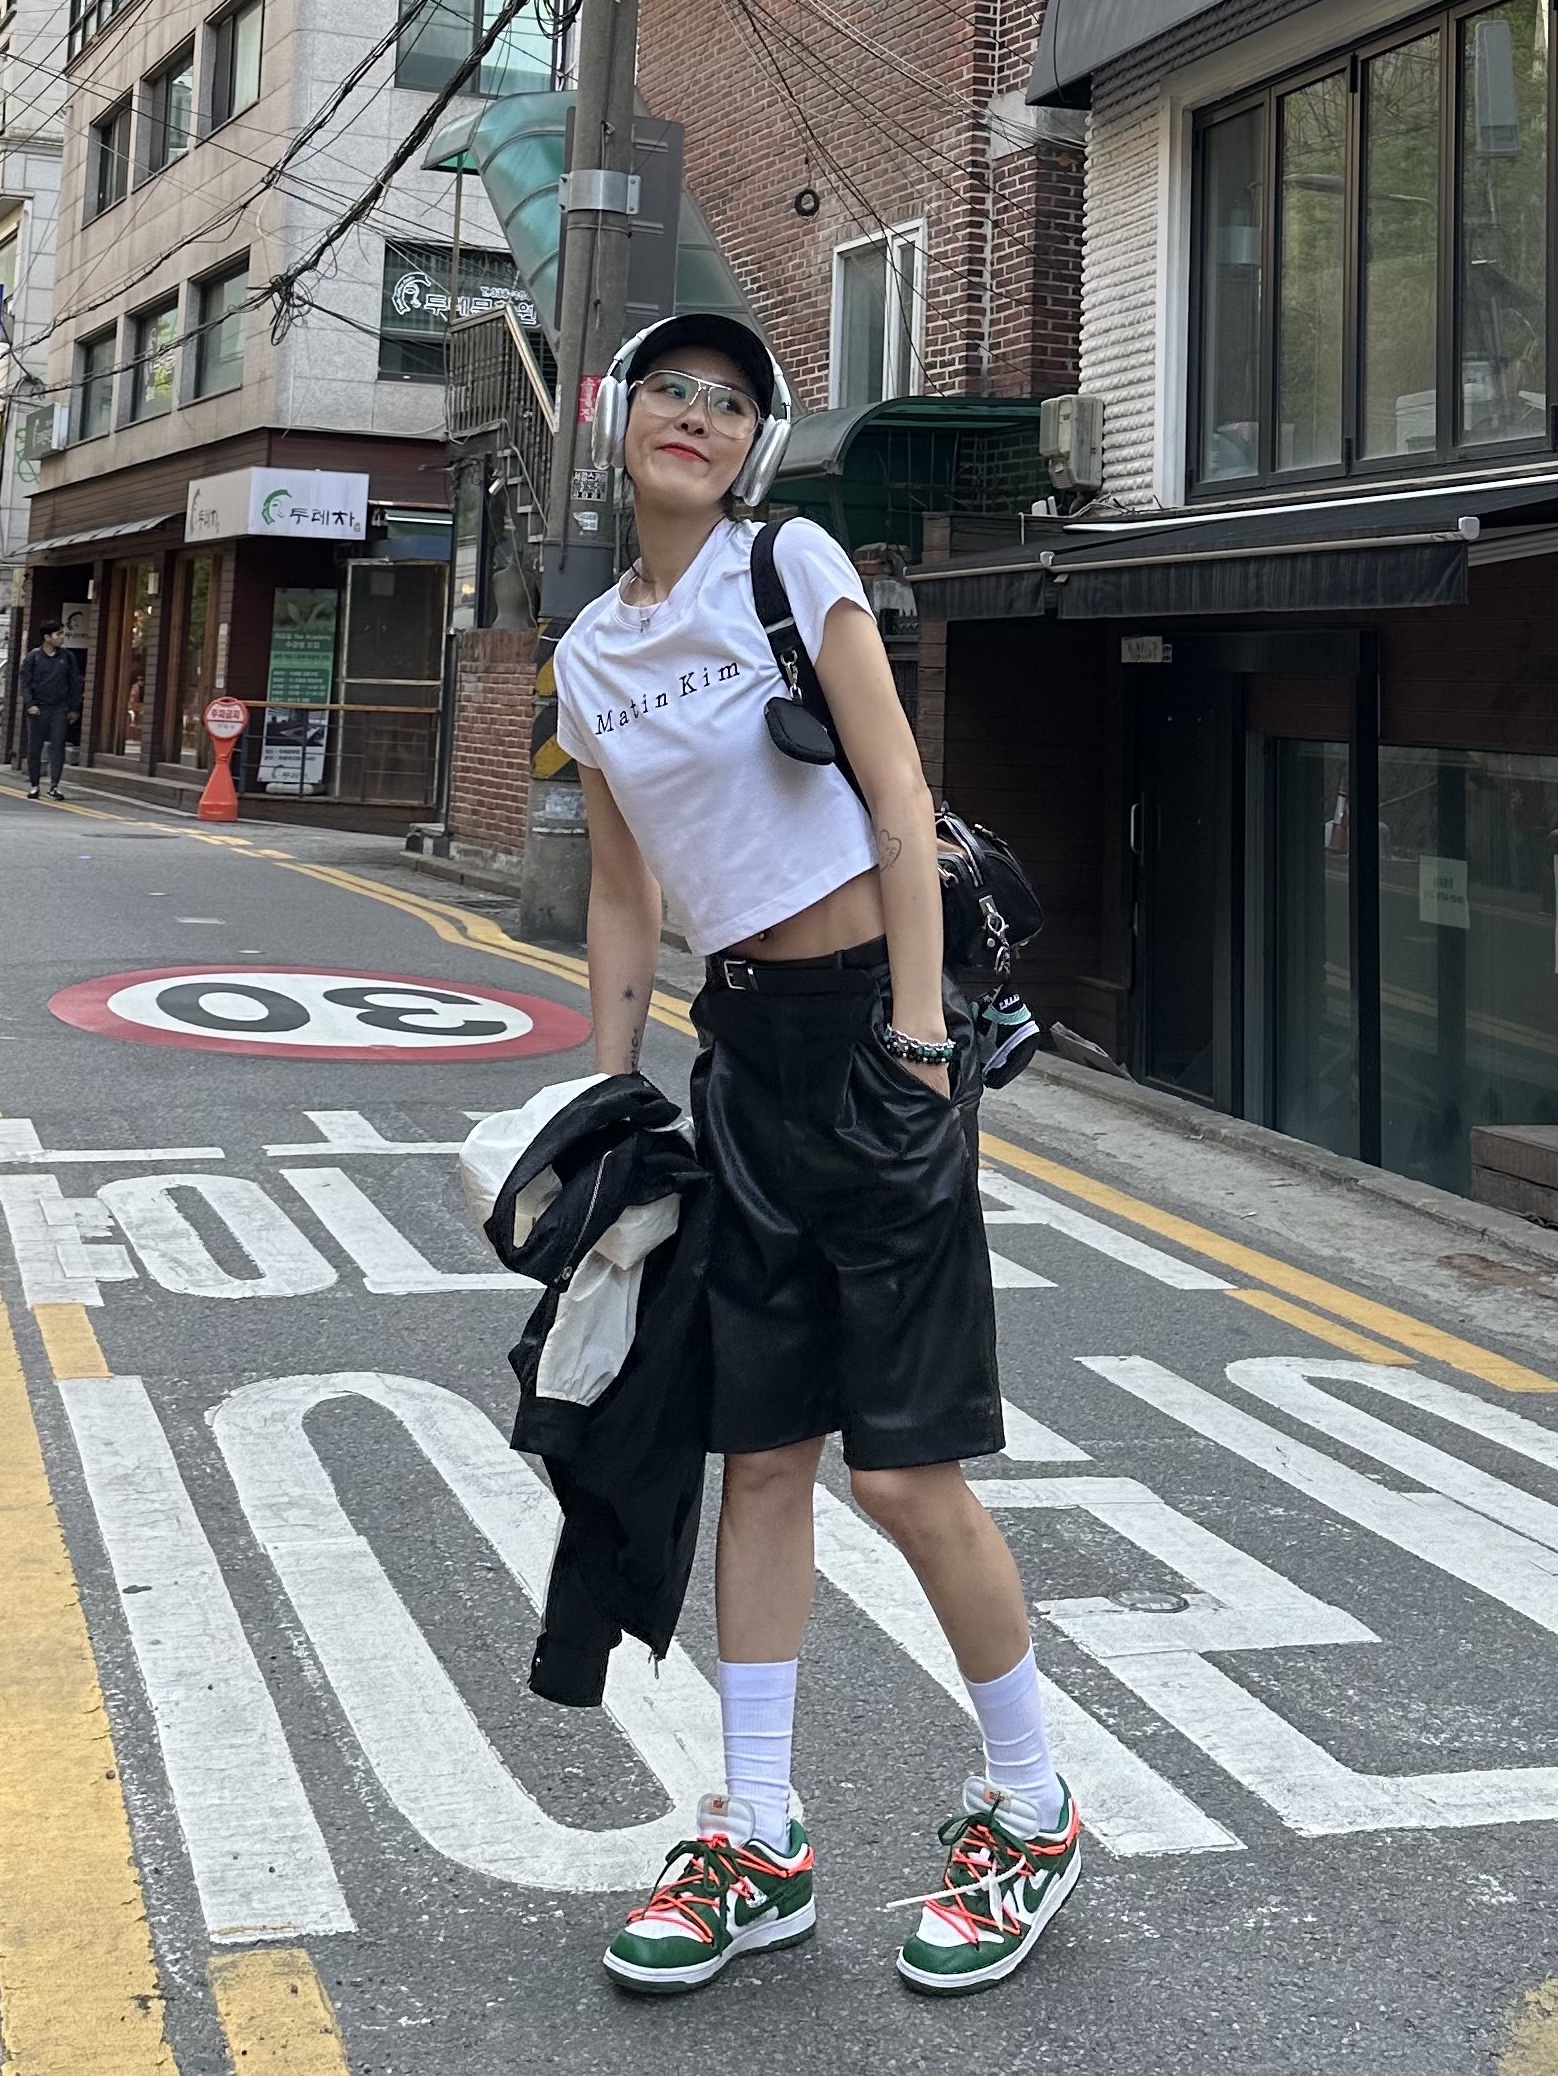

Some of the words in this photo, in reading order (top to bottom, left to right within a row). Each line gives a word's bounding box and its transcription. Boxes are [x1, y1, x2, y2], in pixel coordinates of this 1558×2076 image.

[594, 692, 669, 736] Matin
[678, 661, 741, 698] Kim
[156, 981, 509, 1037] 30
